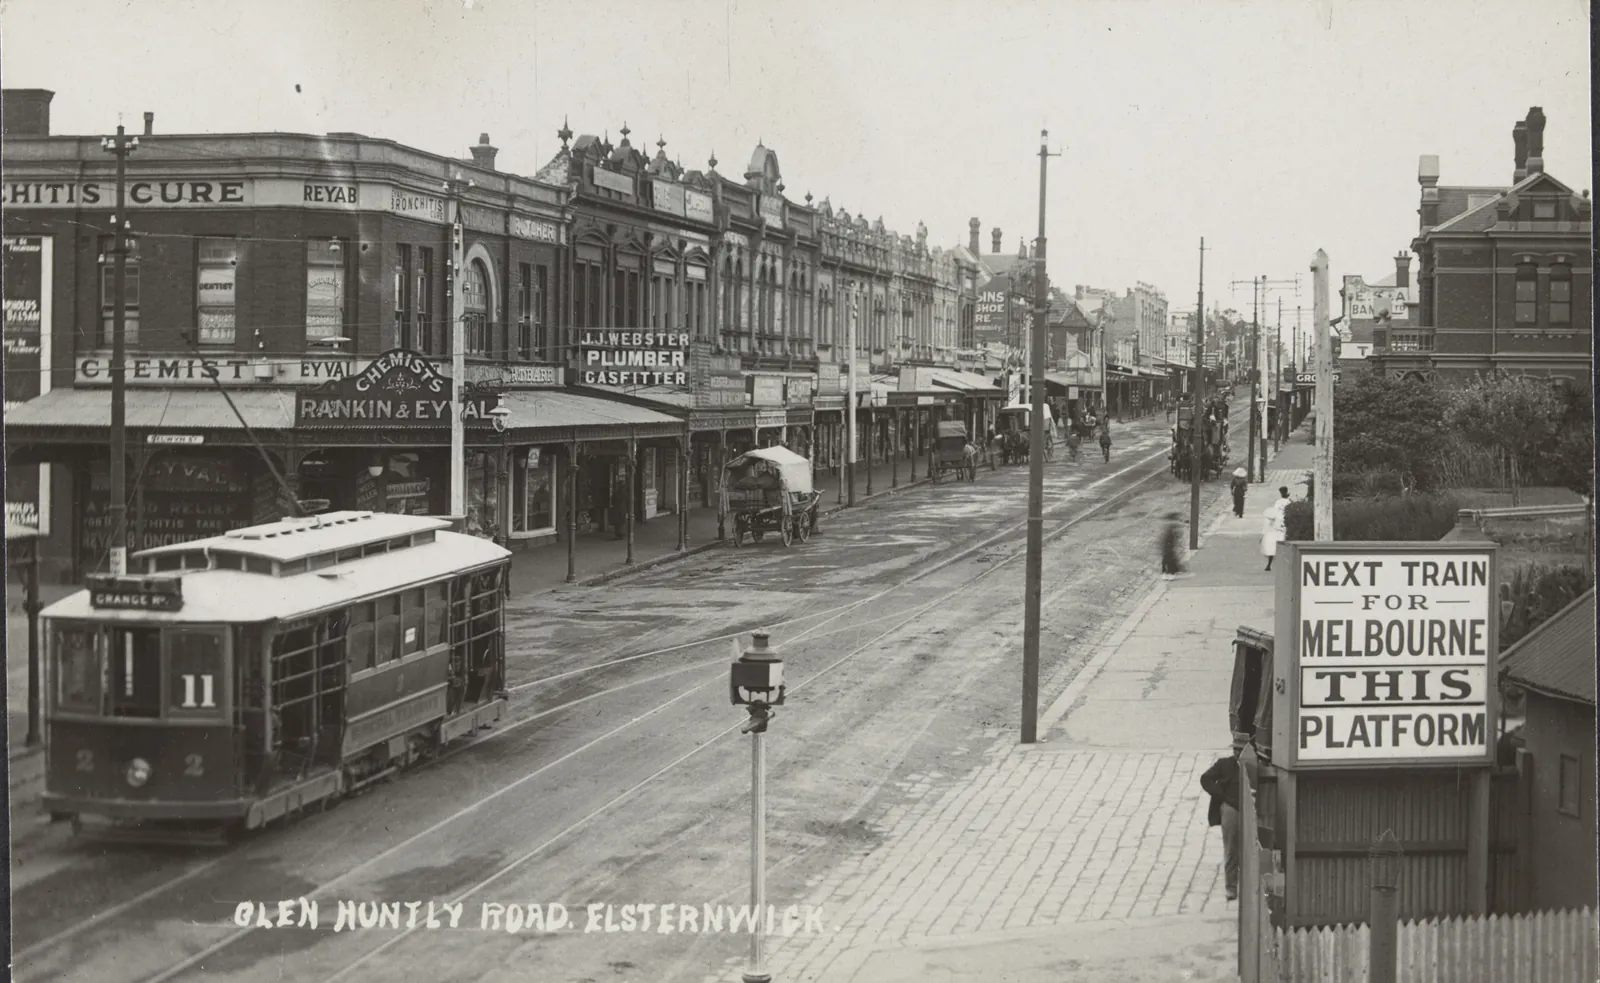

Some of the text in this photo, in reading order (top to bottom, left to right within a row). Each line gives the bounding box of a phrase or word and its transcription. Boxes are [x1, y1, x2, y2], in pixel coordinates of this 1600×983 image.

[130, 182, 244, 203] CURE
[303, 184, 357, 203] REYAB
[301, 361, 354, 378] EYVAL
[587, 350, 684, 367] PLUMBER
[356, 352, 444, 393] CHEMISTS
[585, 371, 686, 385] GASFITTER
[301, 399, 391, 420] RANKIN
[396, 404, 410, 418] &
[1303, 560, 1487, 587] NEXT TRAIN
[96, 594, 147, 605] GRANGE
[1361, 594, 1429, 611] FOR
[1302, 619, 1486, 658] MELBOURNE
[181, 674, 216, 708] 11
[1315, 669, 1472, 702] THIS
[1299, 713, 1486, 749] PLATFORM
[76, 748, 94, 773] 2
[183, 753, 204, 777] 2
